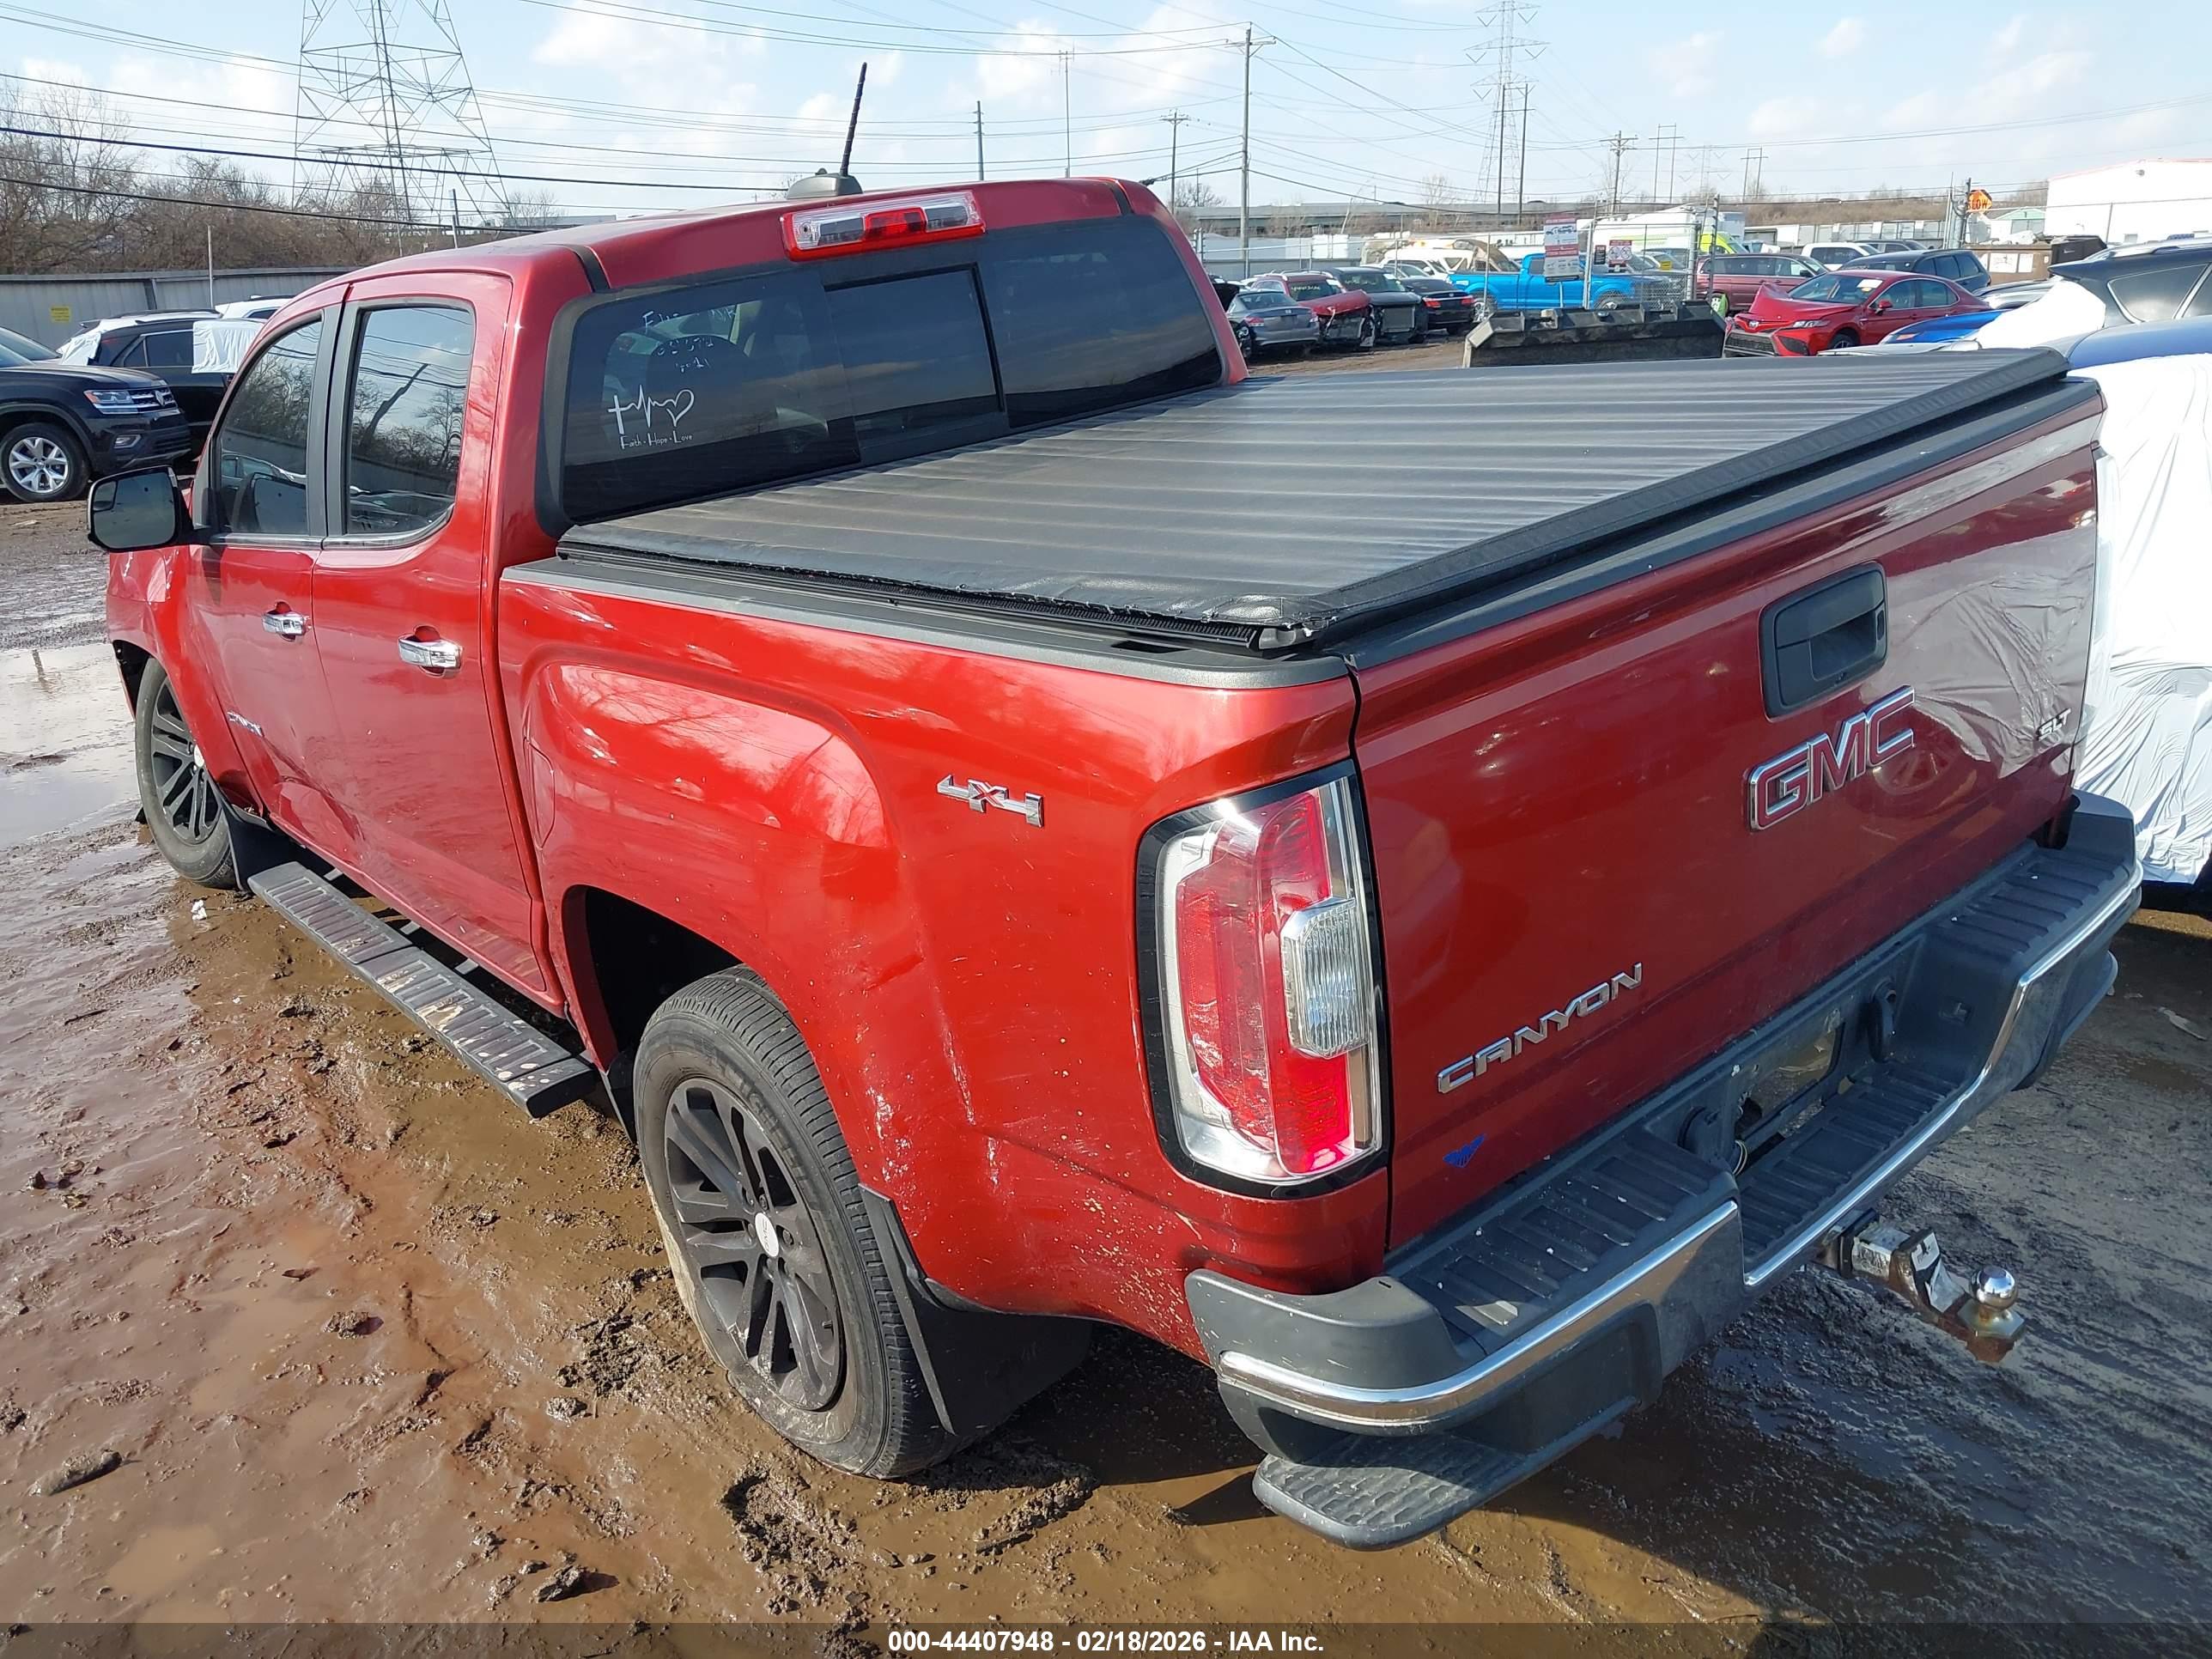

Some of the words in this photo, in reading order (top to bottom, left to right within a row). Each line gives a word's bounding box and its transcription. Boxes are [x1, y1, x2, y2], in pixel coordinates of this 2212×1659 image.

[620, 434, 642, 449] Faith
[647, 432, 668, 446] Hope
[672, 430, 693, 443] Love
[1747, 684, 1916, 831] GMC
[2038, 708, 2072, 742] SLT
[1437, 962, 1643, 1095] CANYON
